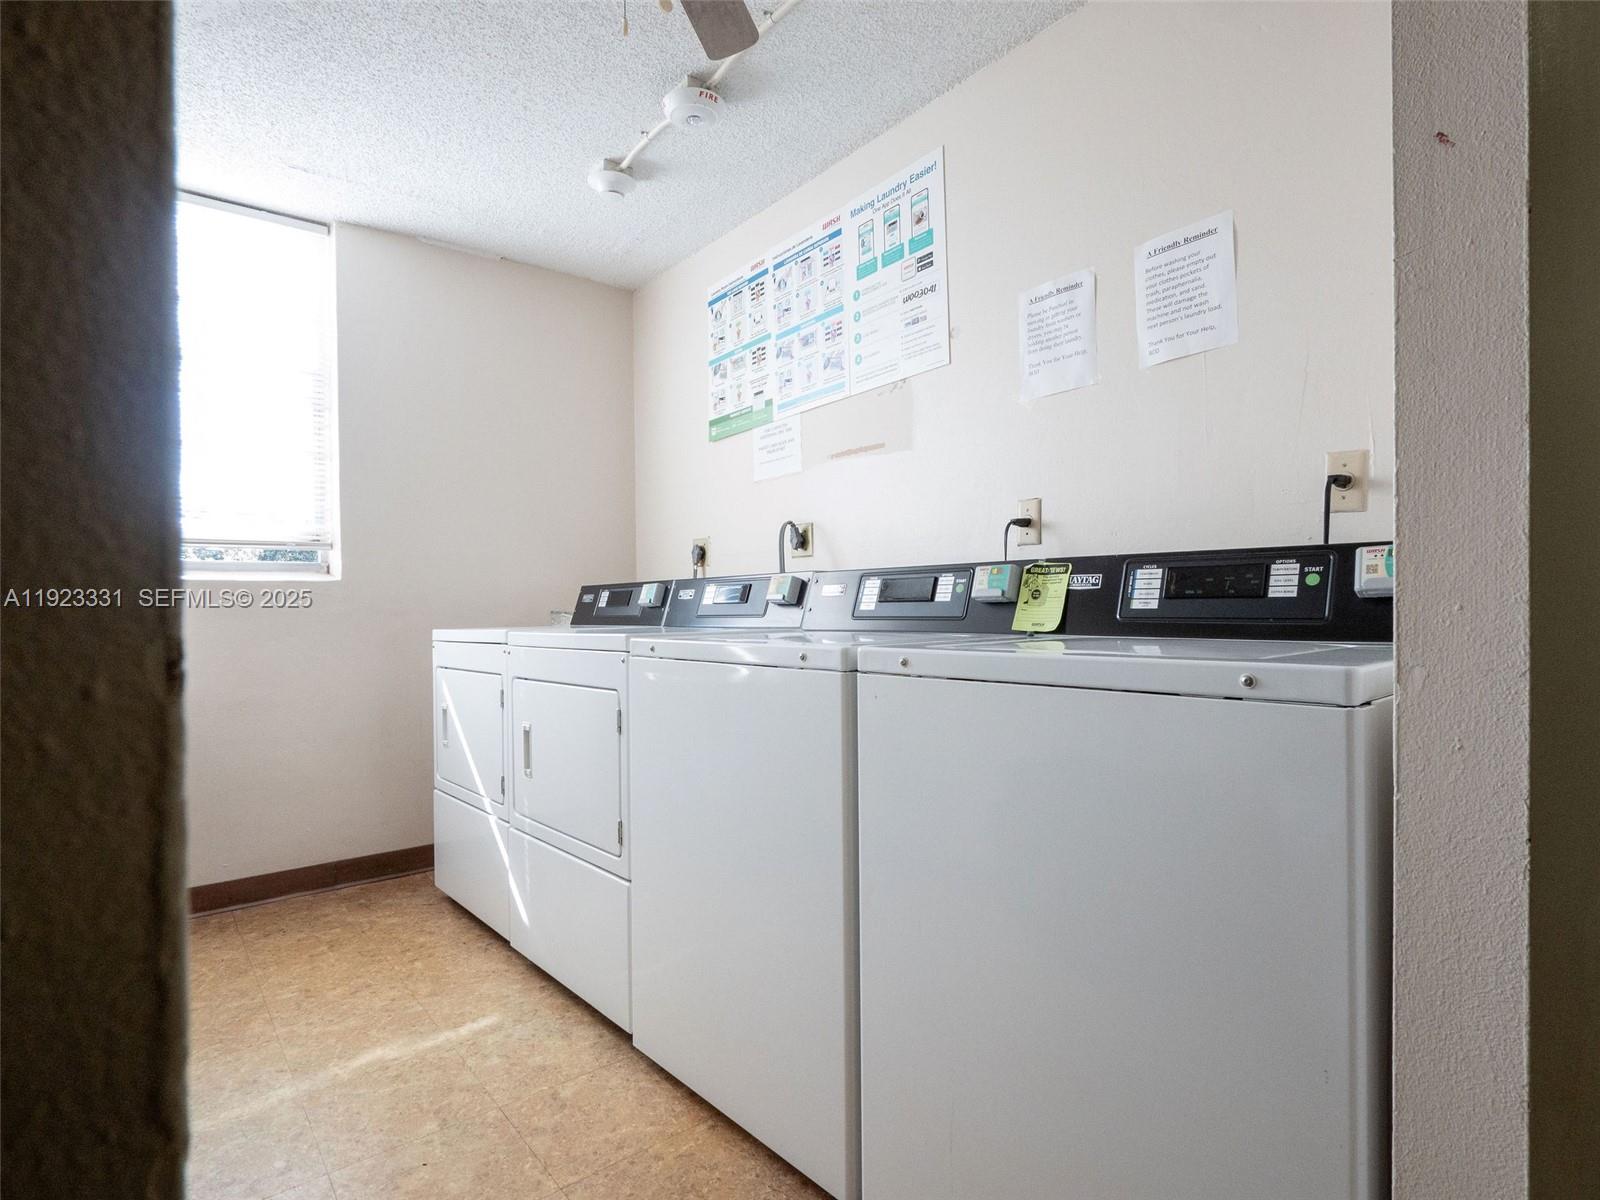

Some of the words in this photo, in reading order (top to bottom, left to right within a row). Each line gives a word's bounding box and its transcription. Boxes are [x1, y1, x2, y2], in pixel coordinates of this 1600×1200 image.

[699, 91, 719, 104] FIRE
[849, 199, 875, 219] Making
[877, 180, 908, 203] Laundry
[909, 160, 937, 184] Easier!
[1153, 240, 1181, 255] Friendly
[1183, 227, 1218, 244] Reminder
[1164, 256, 1187, 268] washing
[1188, 251, 1201, 260] your
[1167, 265, 1185, 276] please
[1186, 259, 1205, 269] empty
[1206, 253, 1216, 262] out
[1159, 275, 1178, 285] clothes
[1180, 268, 1202, 280] pockets
[1203, 263, 1209, 271] of
[1180, 288, 1191, 296] and
[1174, 295, 1197, 306] damage
[1170, 307, 1182, 315] and
[1184, 308, 1207, 319] laundry
